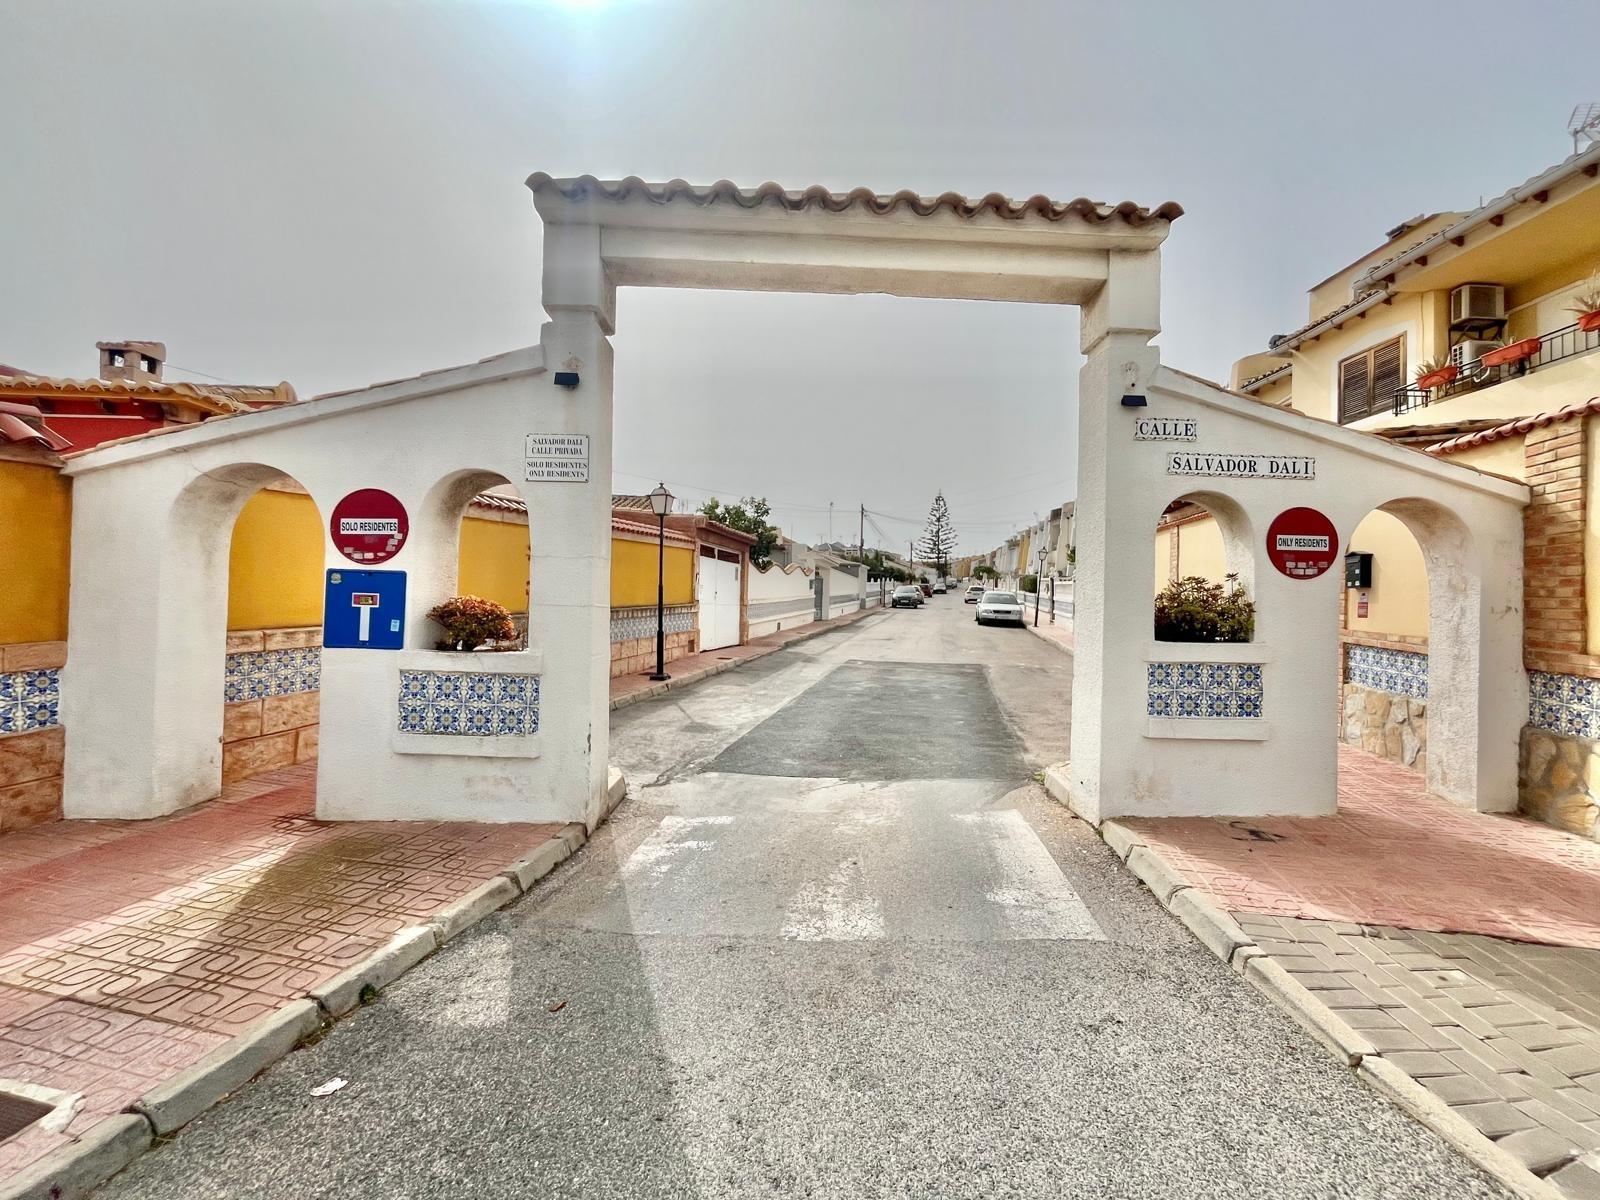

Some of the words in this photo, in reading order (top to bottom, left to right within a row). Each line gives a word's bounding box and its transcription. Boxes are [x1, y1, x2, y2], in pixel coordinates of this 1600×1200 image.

[1139, 422, 1194, 437] CALLE
[532, 446, 552, 454] CALLE
[1172, 456, 1258, 474] SALVADOR
[1269, 460, 1310, 475] DALI
[342, 522, 358, 531] SOLO
[360, 522, 398, 531] RESIDENTES
[1278, 538, 1294, 547] ONLY
[1294, 538, 1328, 548] RESIDENTS
